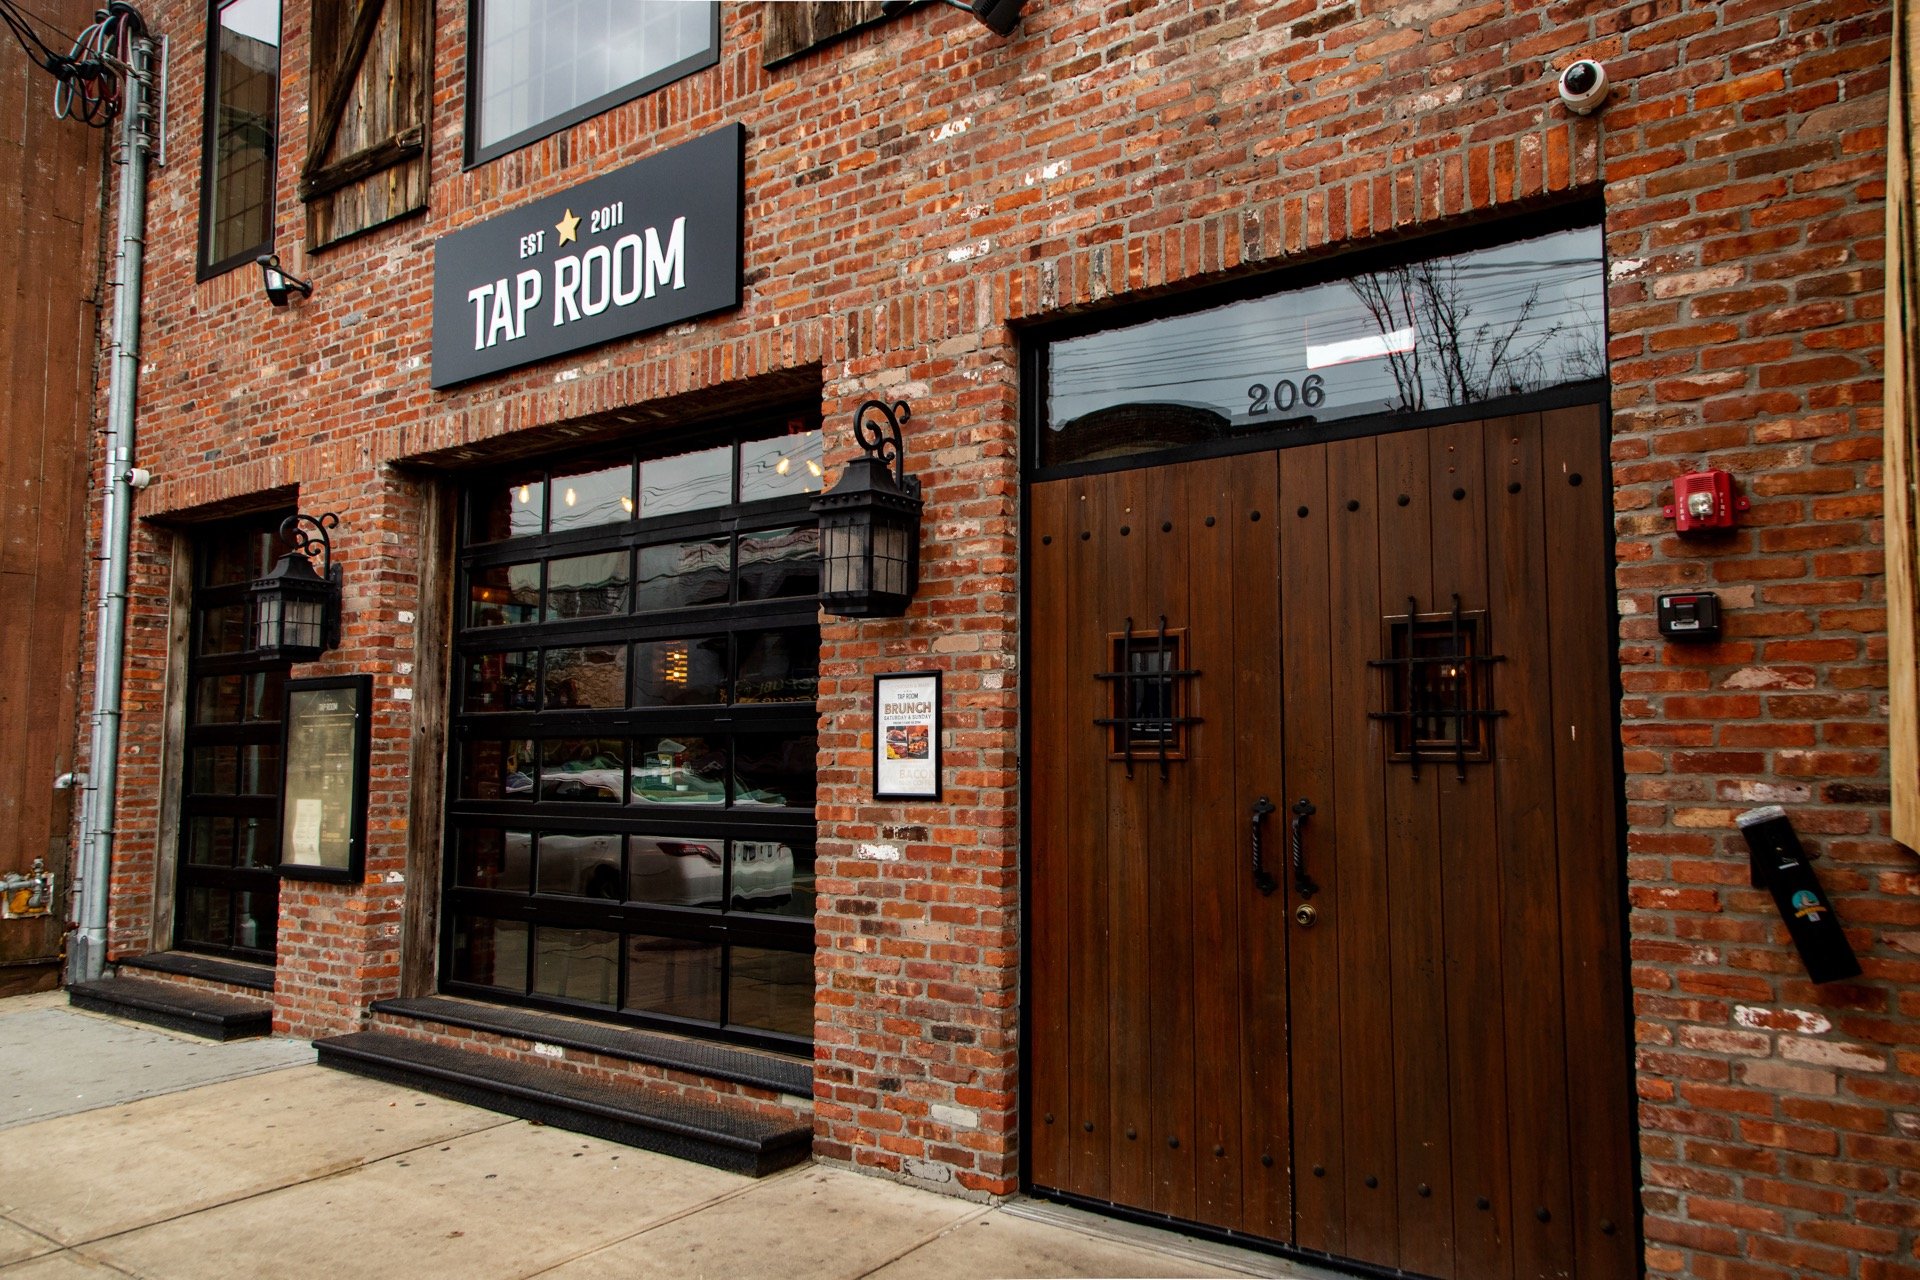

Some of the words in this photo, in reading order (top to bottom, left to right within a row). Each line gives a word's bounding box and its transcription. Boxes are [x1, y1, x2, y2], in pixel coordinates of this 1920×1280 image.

[520, 230, 545, 259] EST
[591, 201, 624, 234] 2011
[467, 268, 543, 351] TAP
[553, 216, 687, 327] ROOM
[1247, 374, 1326, 417] 206
[884, 701, 932, 714] BRUNCH
